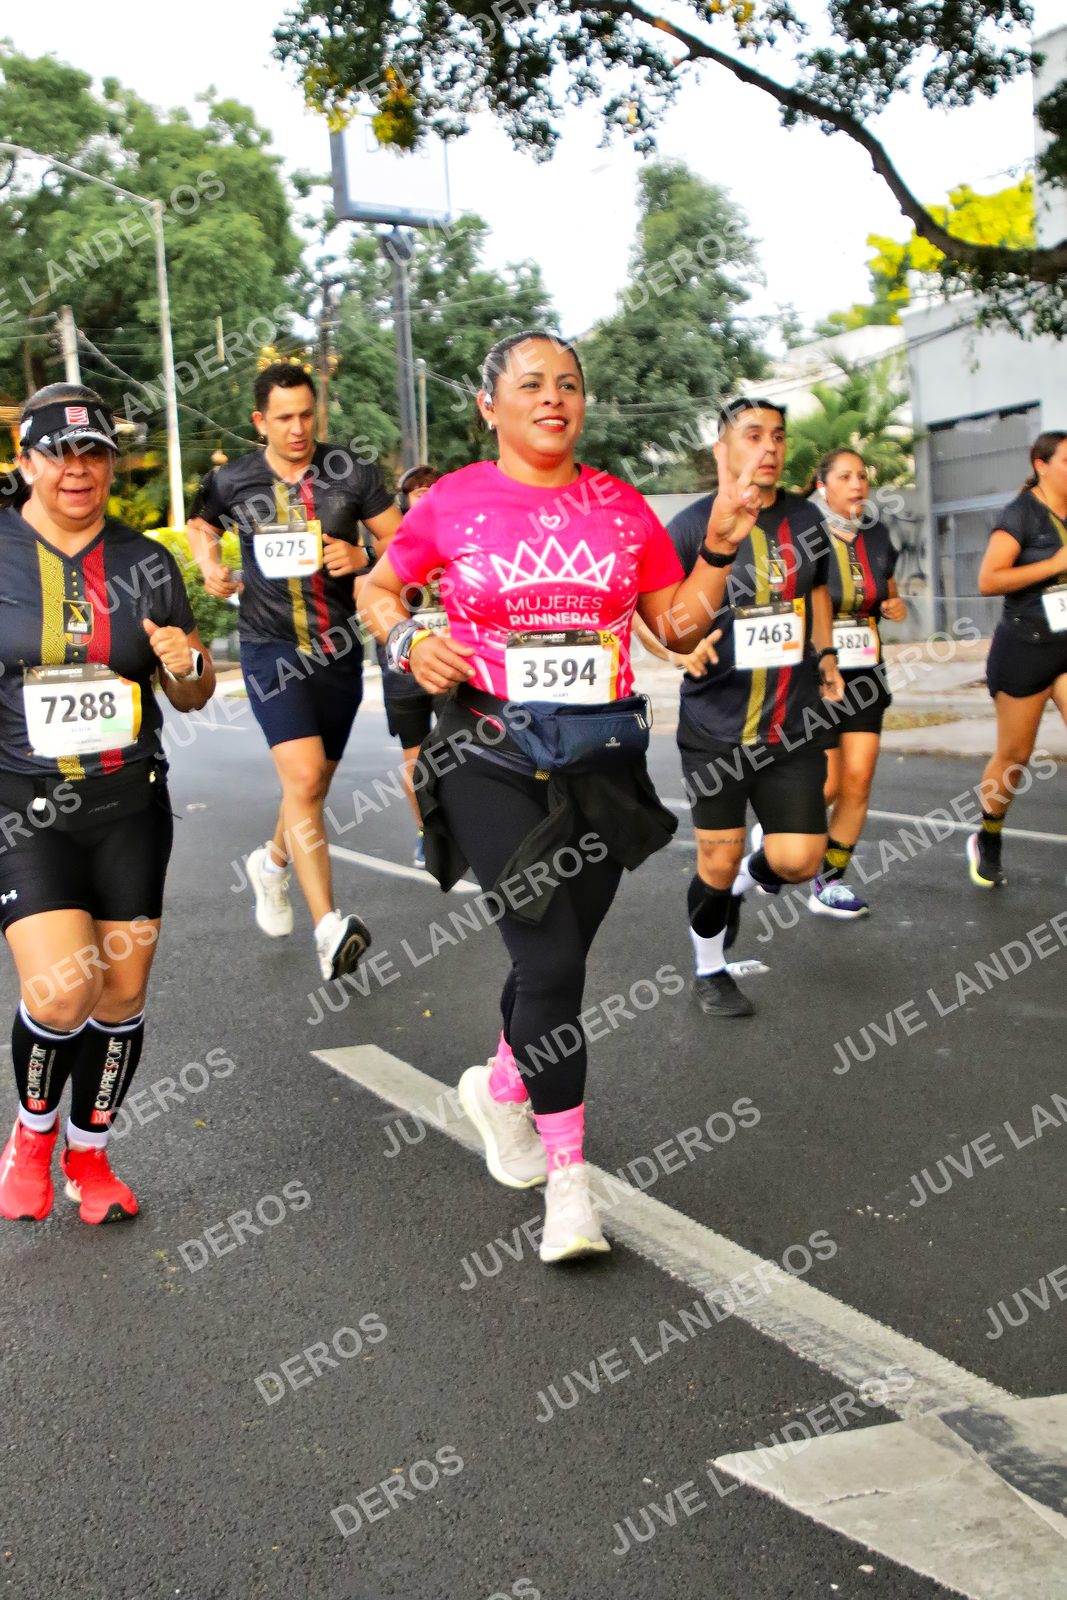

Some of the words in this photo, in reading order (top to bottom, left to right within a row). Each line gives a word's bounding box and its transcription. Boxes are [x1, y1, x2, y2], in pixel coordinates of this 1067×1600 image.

[264, 539, 306, 558] 6275
[505, 595, 604, 612] MUJERES
[421, 618, 448, 630] 644
[509, 612, 600, 626] RUNNERAS
[745, 622, 793, 646] 7463
[837, 633, 870, 649] 3820
[522, 658, 597, 688] 3594
[41, 691, 117, 724] 7288
